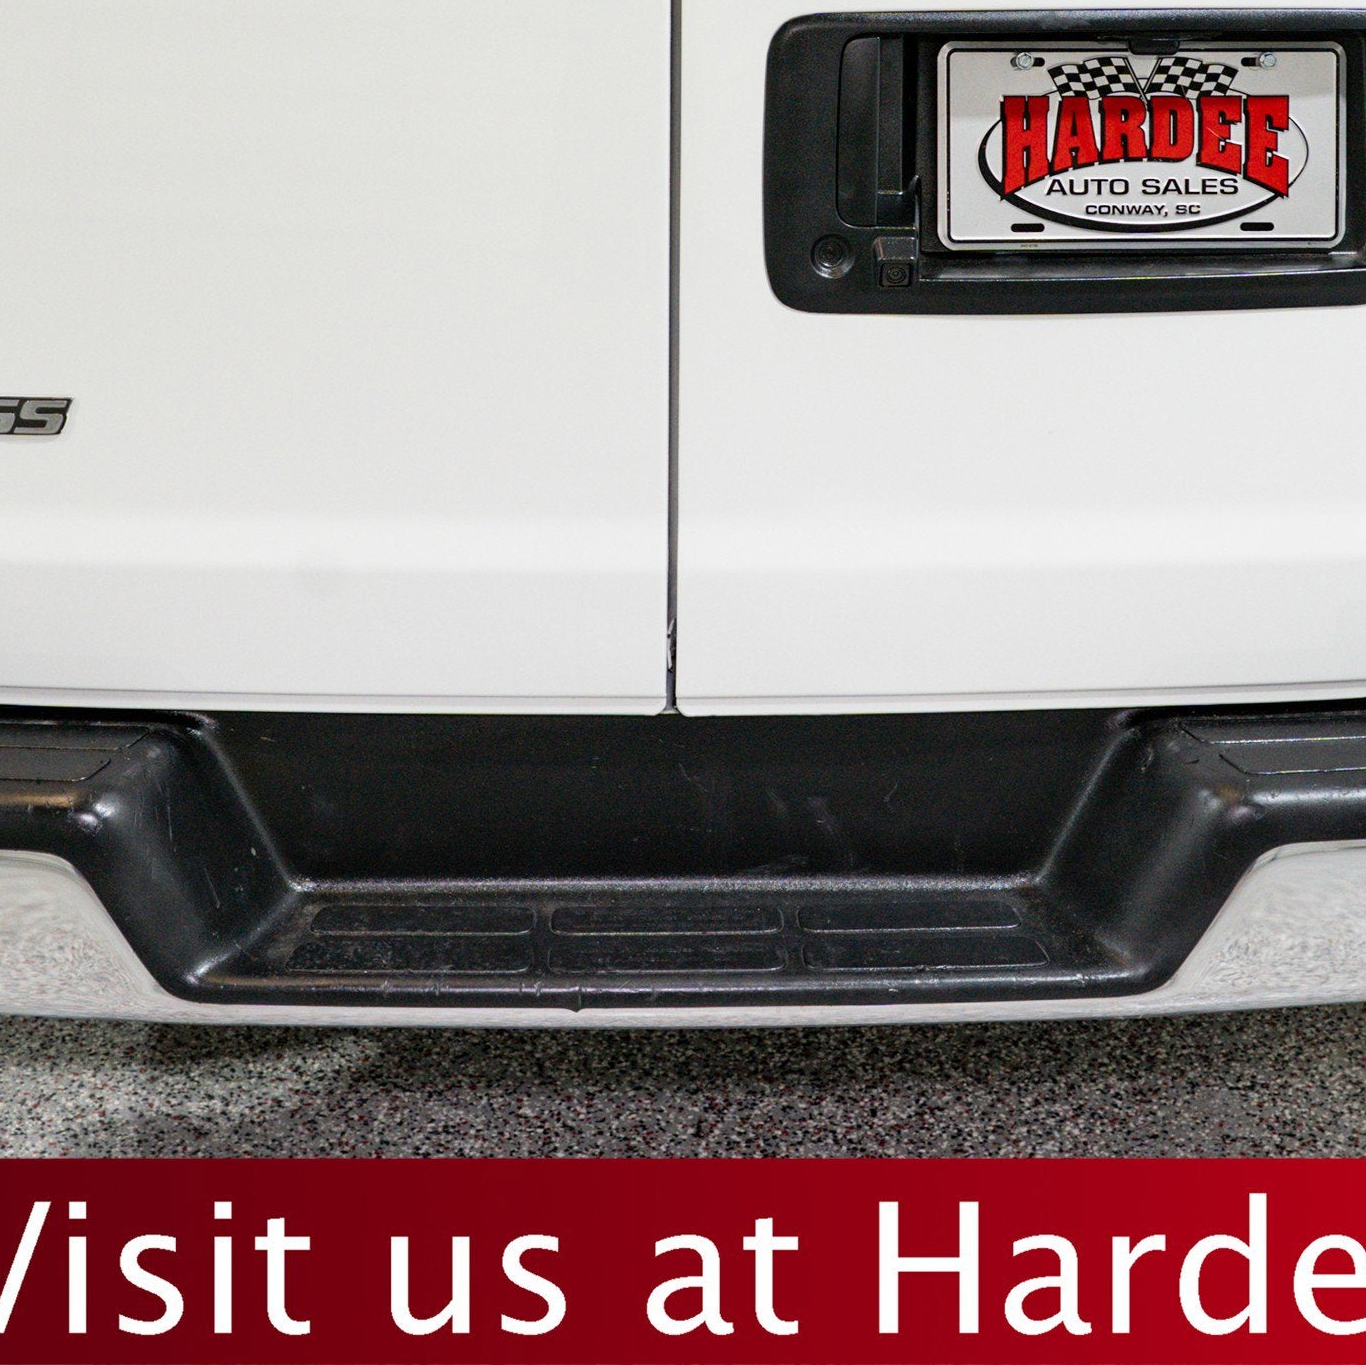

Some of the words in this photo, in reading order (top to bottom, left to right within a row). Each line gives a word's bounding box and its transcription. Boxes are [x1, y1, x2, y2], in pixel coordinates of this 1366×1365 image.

[998, 94, 1291, 200] HARDEE
[1045, 177, 1129, 197] AUTO
[1141, 177, 1240, 197] SALES
[1084, 203, 1170, 218] CONWAY,
[1174, 203, 1202, 216] SC
